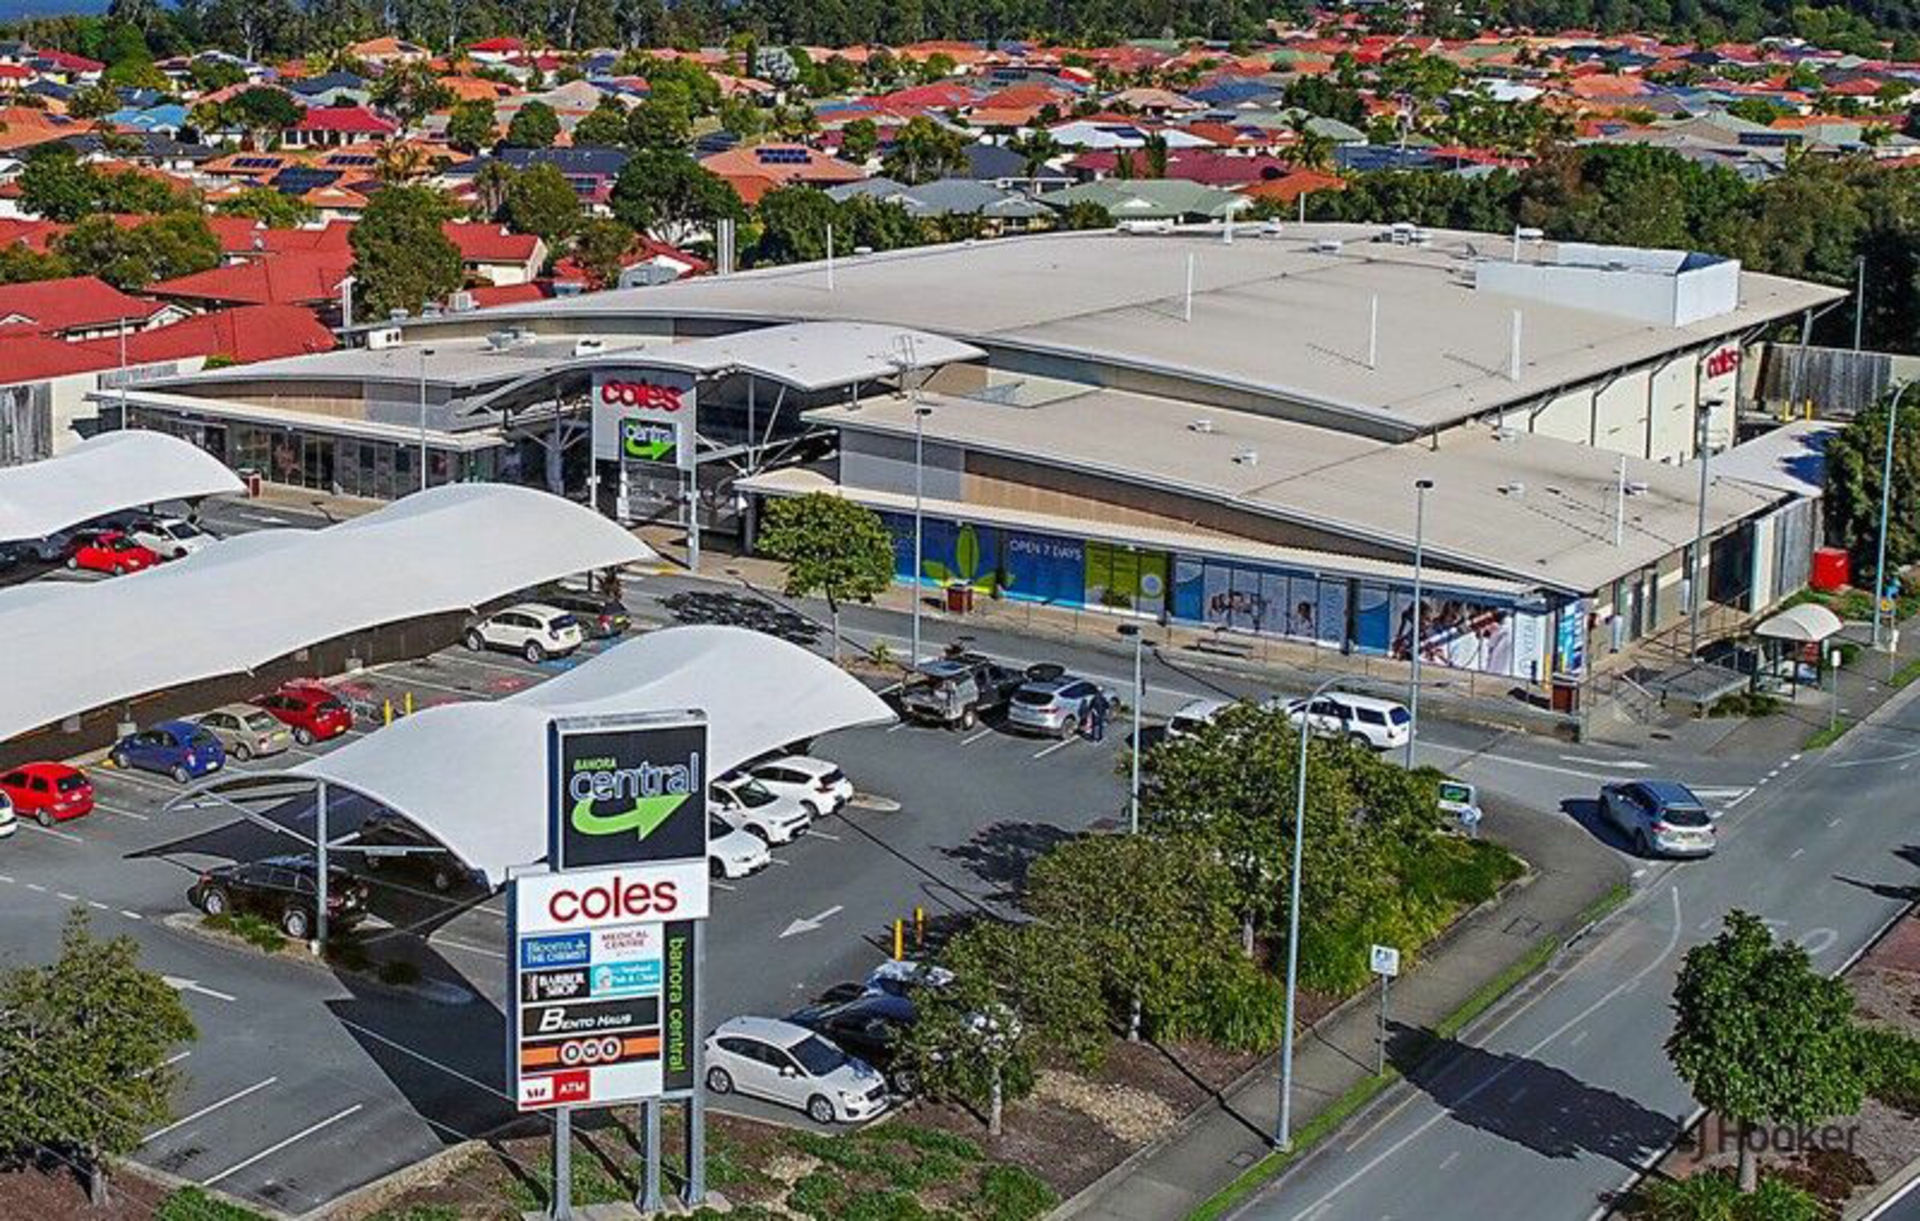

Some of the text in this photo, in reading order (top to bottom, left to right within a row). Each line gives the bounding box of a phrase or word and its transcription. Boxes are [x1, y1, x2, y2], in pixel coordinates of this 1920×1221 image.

[601, 378, 681, 411] coles
[1009, 538, 1083, 561] OPEN 7 DAYS
[569, 752, 700, 801] central
[549, 876, 678, 922] coles
[669, 937, 686, 1071] banora central
[559, 1080, 587, 1093] ATM
